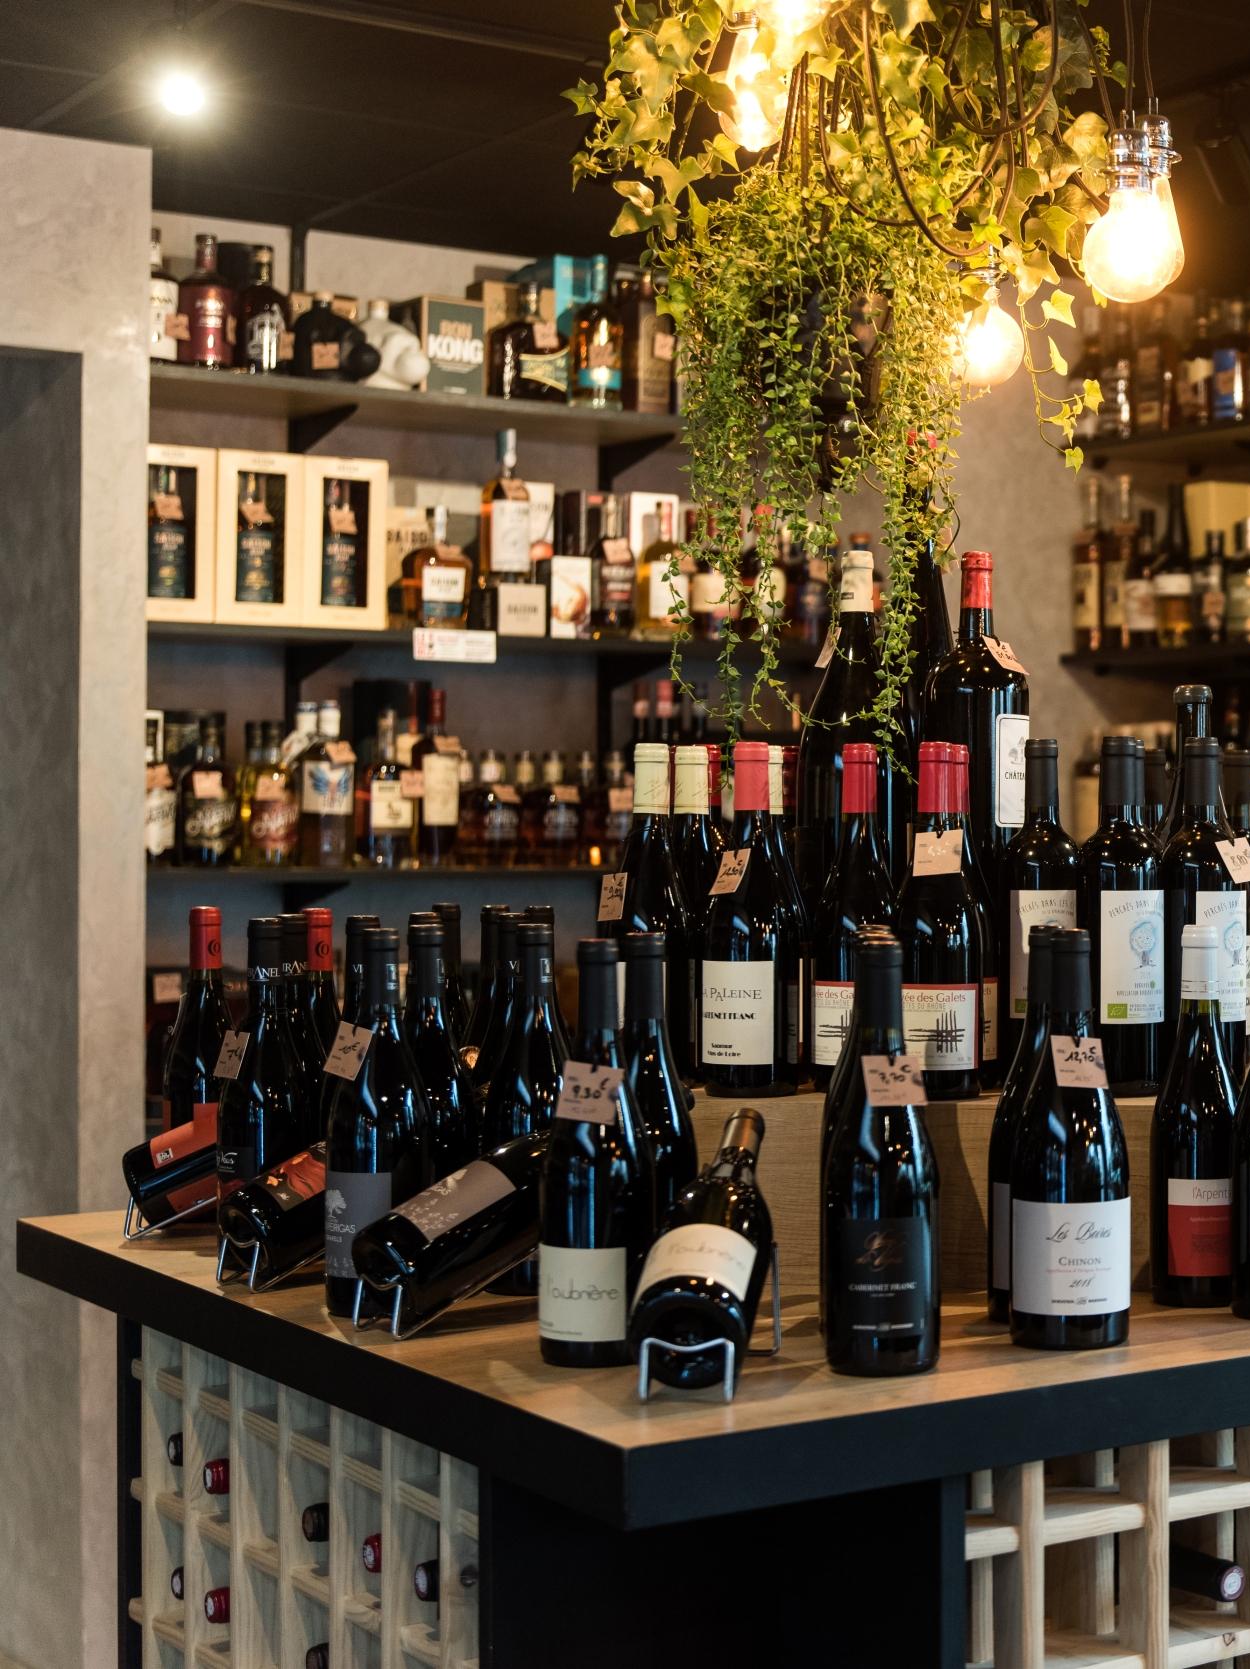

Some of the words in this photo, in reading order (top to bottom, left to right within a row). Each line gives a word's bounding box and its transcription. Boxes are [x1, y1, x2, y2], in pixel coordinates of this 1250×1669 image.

[427, 334, 484, 364] KONG
[710, 987, 762, 1002] PALEINE
[825, 988, 839, 1000] des
[917, 991, 934, 1003] des
[936, 992, 966, 1003] Galets
[1045, 1221, 1071, 1243] Les
